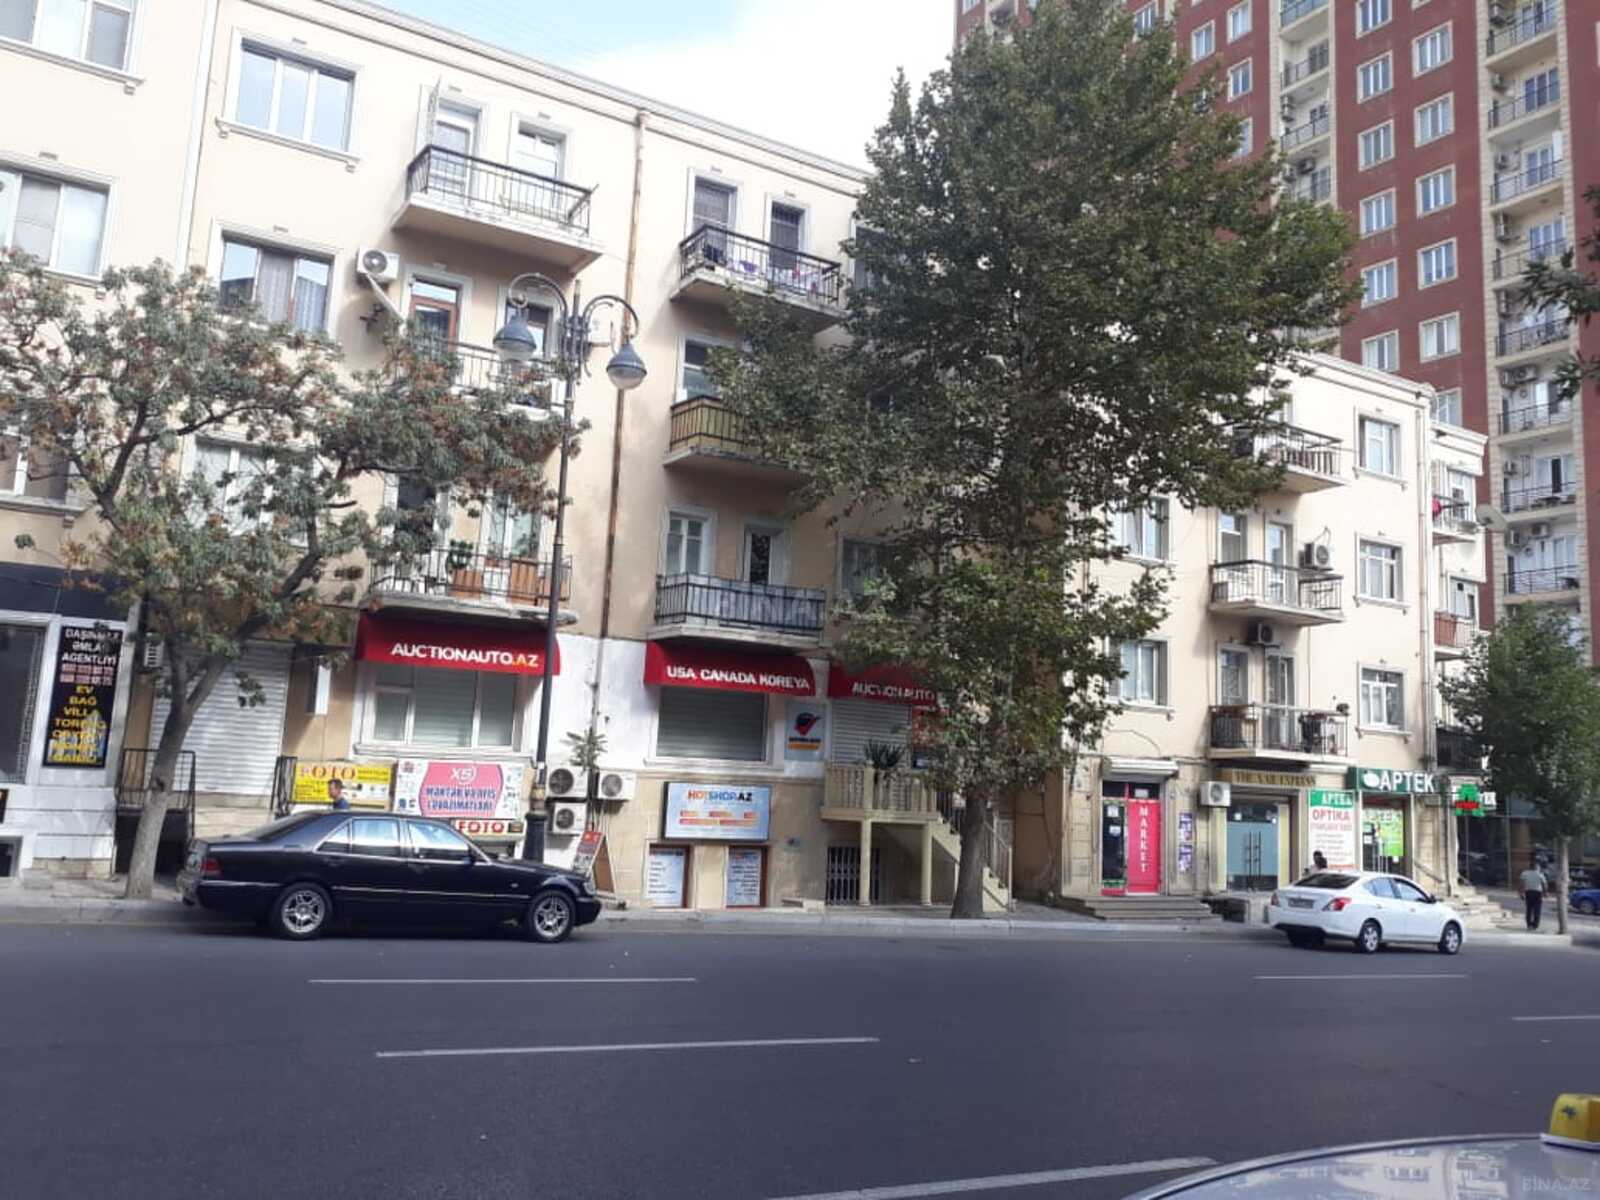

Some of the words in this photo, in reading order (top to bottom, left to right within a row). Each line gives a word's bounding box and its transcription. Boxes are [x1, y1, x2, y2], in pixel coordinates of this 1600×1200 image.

[391, 643, 539, 667] AUCTIONAUTO.AZ
[667, 665, 697, 679] USA
[700, 669, 757, 684] CANADA
[759, 674, 809, 689] KOREYA
[1380, 771, 1435, 793] APTEK
[459, 820, 504, 833] FOTO
[1139, 805, 1149, 873] MARKET
